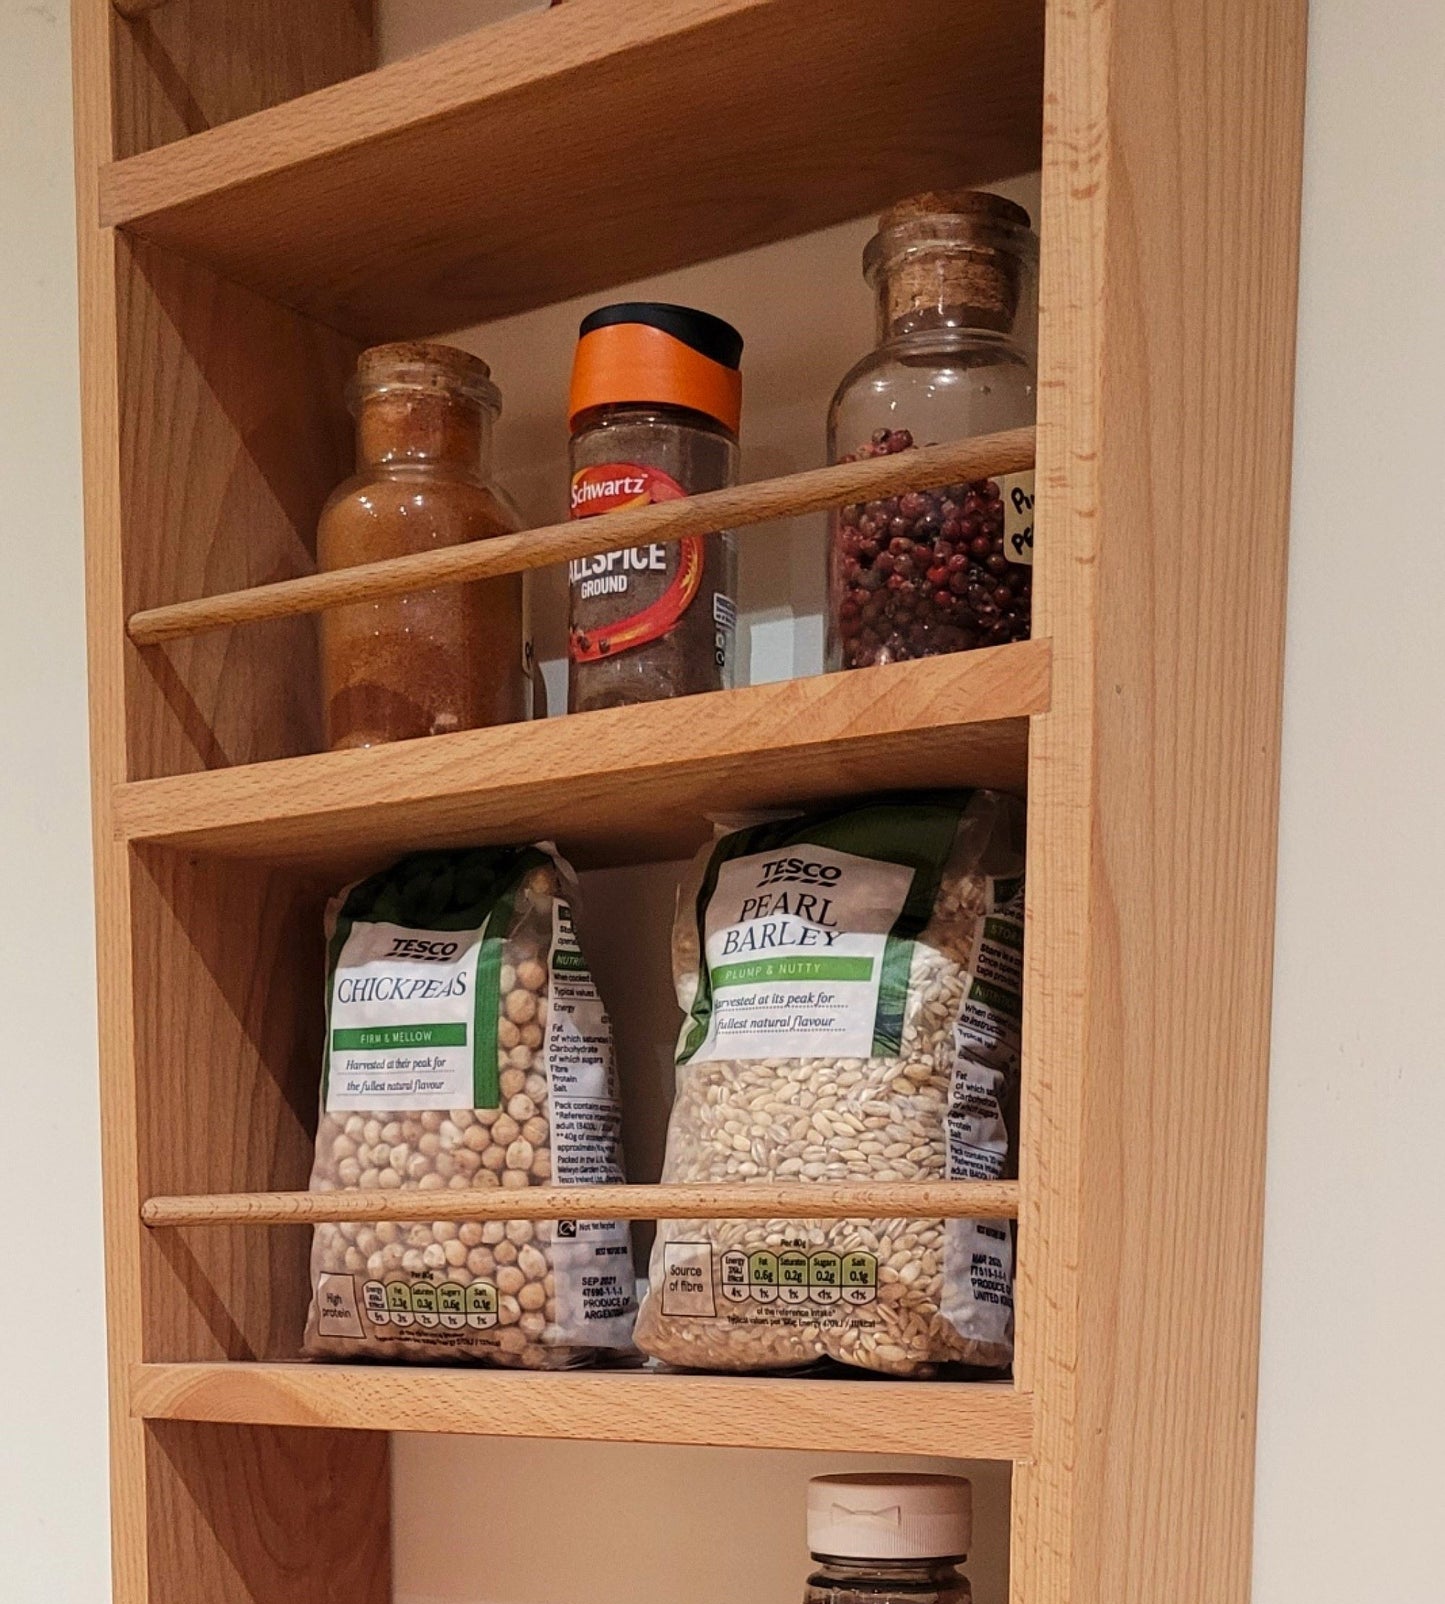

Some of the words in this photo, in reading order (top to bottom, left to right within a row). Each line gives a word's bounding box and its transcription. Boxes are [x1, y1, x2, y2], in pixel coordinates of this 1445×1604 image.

[571, 476, 645, 508] Schwartz
[581, 574, 627, 599] GROUND
[762, 858, 842, 880] TESCO
[737, 891, 838, 928] PEARL
[721, 921, 847, 956] BARLEY
[392, 938, 458, 956] TESCO
[725, 966, 762, 980] PLUMP
[766, 966, 773, 975] &
[779, 963, 821, 974] NUTTY
[337, 971, 467, 1004] CHICKPEAS
[714, 994, 756, 1009] arvested
[757, 995, 769, 1005] at
[771, 993, 785, 1004] its
[785, 992, 815, 1007] peak
[814, 991, 835, 1007] for
[717, 1018, 750, 1031] fullest
[750, 1015, 791, 1027] natural
[790, 1015, 836, 1032] flavour
[360, 1033, 381, 1044] FIRM
[392, 1031, 433, 1043] MELLOW
[346, 1059, 385, 1070] Harvested
[412, 1057, 431, 1071] peak
[431, 1056, 446, 1071] for
[347, 1081, 359, 1091] the
[360, 1080, 385, 1094] fullest
[386, 1081, 413, 1091] natural
[412, 1079, 444, 1093] flavour
[670, 1264, 702, 1276] Source
[813, 1258, 837, 1268] Sugars
[851, 1258, 866, 1267] Salt
[581, 1276, 599, 1286] SEP
[754, 1270, 773, 1282] 0.6g
[784, 1270, 802, 1283] 0.2g
[815, 1270, 835, 1284] 0.2g
[669, 1279, 679, 1292] of
[680, 1280, 704, 1292] fibre
[970, 1277, 1005, 1294] PRODUCE
[583, 1297, 620, 1309] PRODUCE
[973, 1289, 999, 1305] UNITED
